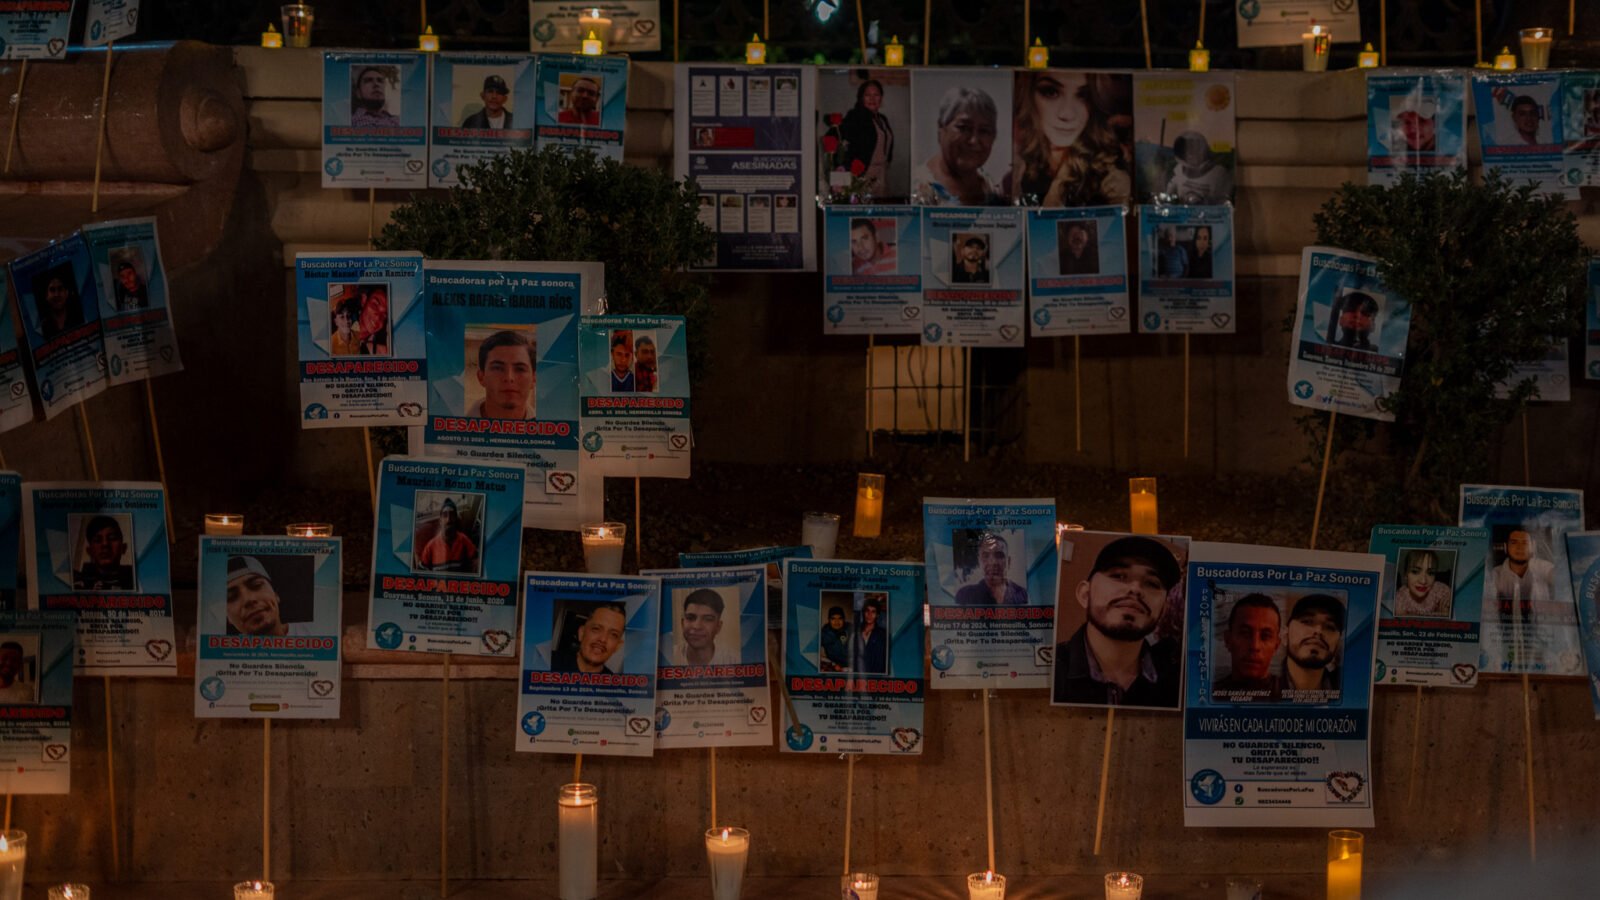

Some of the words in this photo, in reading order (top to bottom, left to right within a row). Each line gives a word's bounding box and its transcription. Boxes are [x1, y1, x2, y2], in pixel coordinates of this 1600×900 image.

[732, 160, 798, 170] ASESINADAS
[301, 260, 347, 269] Buscadoras
[348, 260, 362, 269] Por
[364, 260, 374, 268] La
[375, 260, 390, 268] Paz
[390, 260, 418, 268] Sonora
[430, 276, 486, 286] Buscadoras
[507, 278, 519, 287] La
[522, 279, 538, 288] Paz
[542, 280, 575, 290] sonora
[432, 292, 466, 308] ALEXIS
[470, 294, 504, 308] RAFAEL
[508, 294, 546, 309] IBARRA
[549, 293, 574, 310] RÍOS
[306, 361, 419, 374] DESAPARECIDO
[588, 398, 684, 408] DESAPARECIDO
[434, 417, 570, 436] DESAPARECIDO
[456, 450, 469, 458] No
[471, 450, 505, 459] Guardes
[506, 452, 542, 460] Silencio
[388, 464, 440, 475] Buscadoras
[442, 467, 456, 476] Por
[458, 468, 469, 477] La
[471, 470, 486, 479] Paz
[488, 472, 520, 482] Sonora
[397, 476, 442, 488] Mauricio
[445, 479, 472, 490] Romo
[476, 482, 506, 492] Matus
[1466, 493, 1510, 506] Buscadoras
[1511, 494, 1525, 507] Por
[1527, 497, 1538, 507] La
[1539, 498, 1552, 508] Paz
[1554, 498, 1581, 510] Sonora
[928, 506, 974, 516] Buscadoras
[976, 506, 990, 516] Por
[992, 507, 1003, 515] La
[1004, 508, 1020, 516] Paz
[1021, 507, 1051, 516] Sonora
[994, 517, 1032, 526] Espinoza
[1378, 528, 1420, 536] Buscadoras
[1422, 528, 1434, 536] Por
[1460, 530, 1487, 538] Sonora
[1424, 538, 1442, 546] Lugo
[792, 564, 842, 574] Buscadoras
[844, 566, 858, 575] Por
[860, 567, 871, 576] La
[872, 568, 888, 577] Paz
[890, 569, 920, 578] Sonora
[1197, 566, 1264, 580] Buscadoras
[1267, 568, 1288, 580] Por
[1290, 570, 1302, 581] La
[1306, 572, 1327, 583] Paz
[1329, 574, 1372, 586] Sonora
[382, 577, 511, 597] DESAPARECIDO
[530, 578, 579, 588] Buscadoras
[628, 582, 656, 590] Sonora
[47, 595, 166, 608] DESAPARECIDO
[934, 607, 1054, 620] DESAPARECIDO
[932, 622, 951, 630] Mayo
[990, 622, 1027, 630] Hermosillo,
[1028, 622, 1053, 630] Sonora
[1000, 630, 1030, 638] Silencio
[209, 636, 334, 650] DESAPARECIDO
[944, 638, 964, 646] ¡Grita
[966, 638, 979, 646] Por
[992, 638, 1043, 647] Desaparecido!
[264, 670, 318, 678] Desaparecido!
[658, 664, 764, 680] ESAPARECIDO
[531, 672, 648, 686] DESAPARECIDO
[792, 677, 918, 694] DESAPARECIDO
[536, 704, 557, 712] ¡Grita
[594, 700, 624, 708] Silencio
[860, 704, 892, 712] SILENCIO,
[1200, 714, 1228, 734] VIVIRÁS
[1230, 719, 1241, 733] EN
[1242, 719, 1264, 733] CADA
[1265, 719, 1292, 733] LATIDO
[1294, 719, 1304, 733] DE
[1306, 719, 1316, 733] MI
[1318, 714, 1357, 734] CORAZÓN
[1282, 742, 1326, 750] SILENCIO,
[1232, 756, 1243, 764] TU
[1246, 756, 1320, 764] DESAPARECIDO!!
